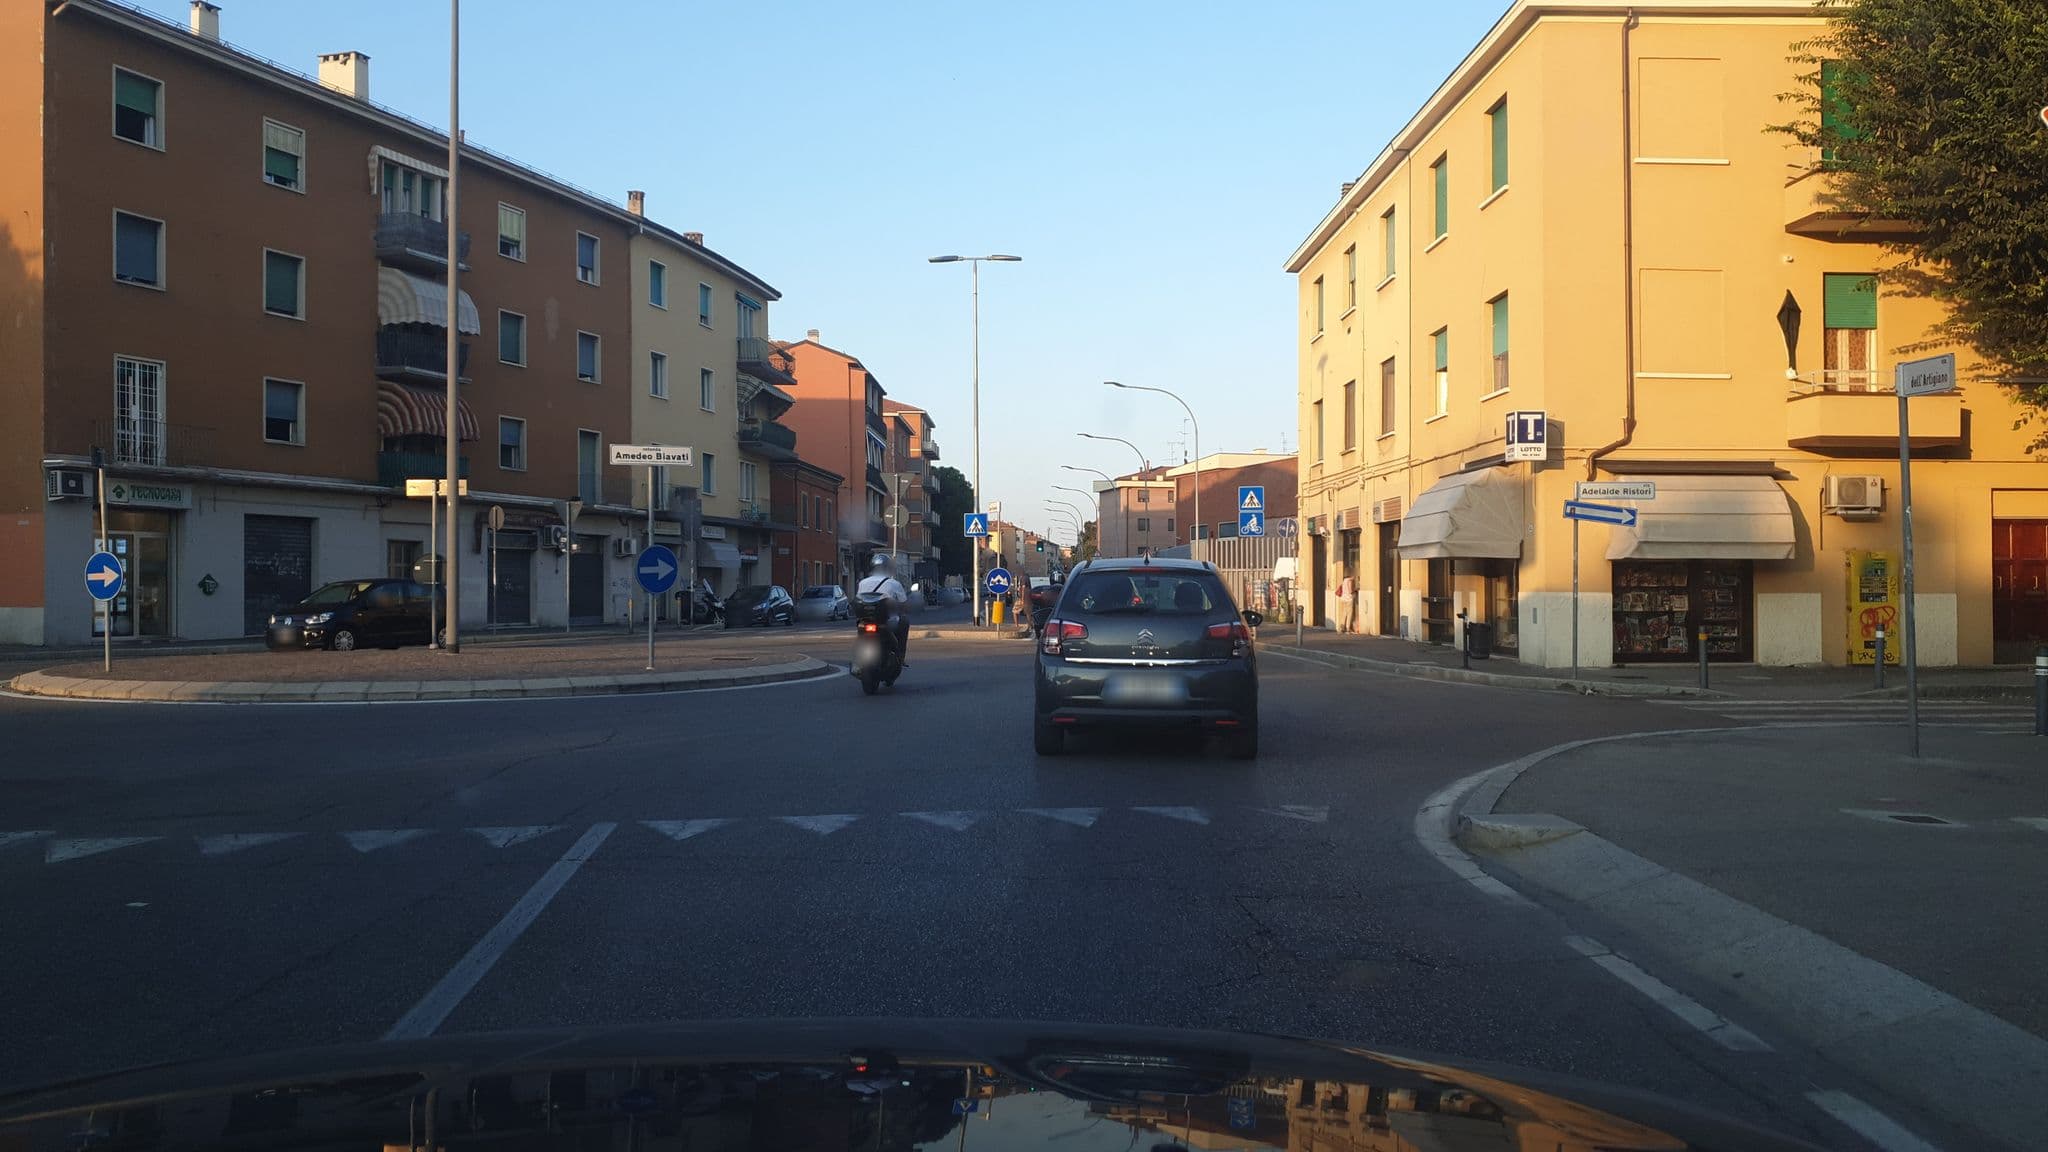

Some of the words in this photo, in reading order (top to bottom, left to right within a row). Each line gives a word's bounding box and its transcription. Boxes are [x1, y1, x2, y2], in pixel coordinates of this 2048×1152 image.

[615, 451, 653, 460] Amedeo
[655, 452, 689, 461] Biavati
[130, 485, 182, 501] TECNOCASA
[1582, 487, 1620, 496] Adelaide
[1622, 487, 1651, 496] Ristori
